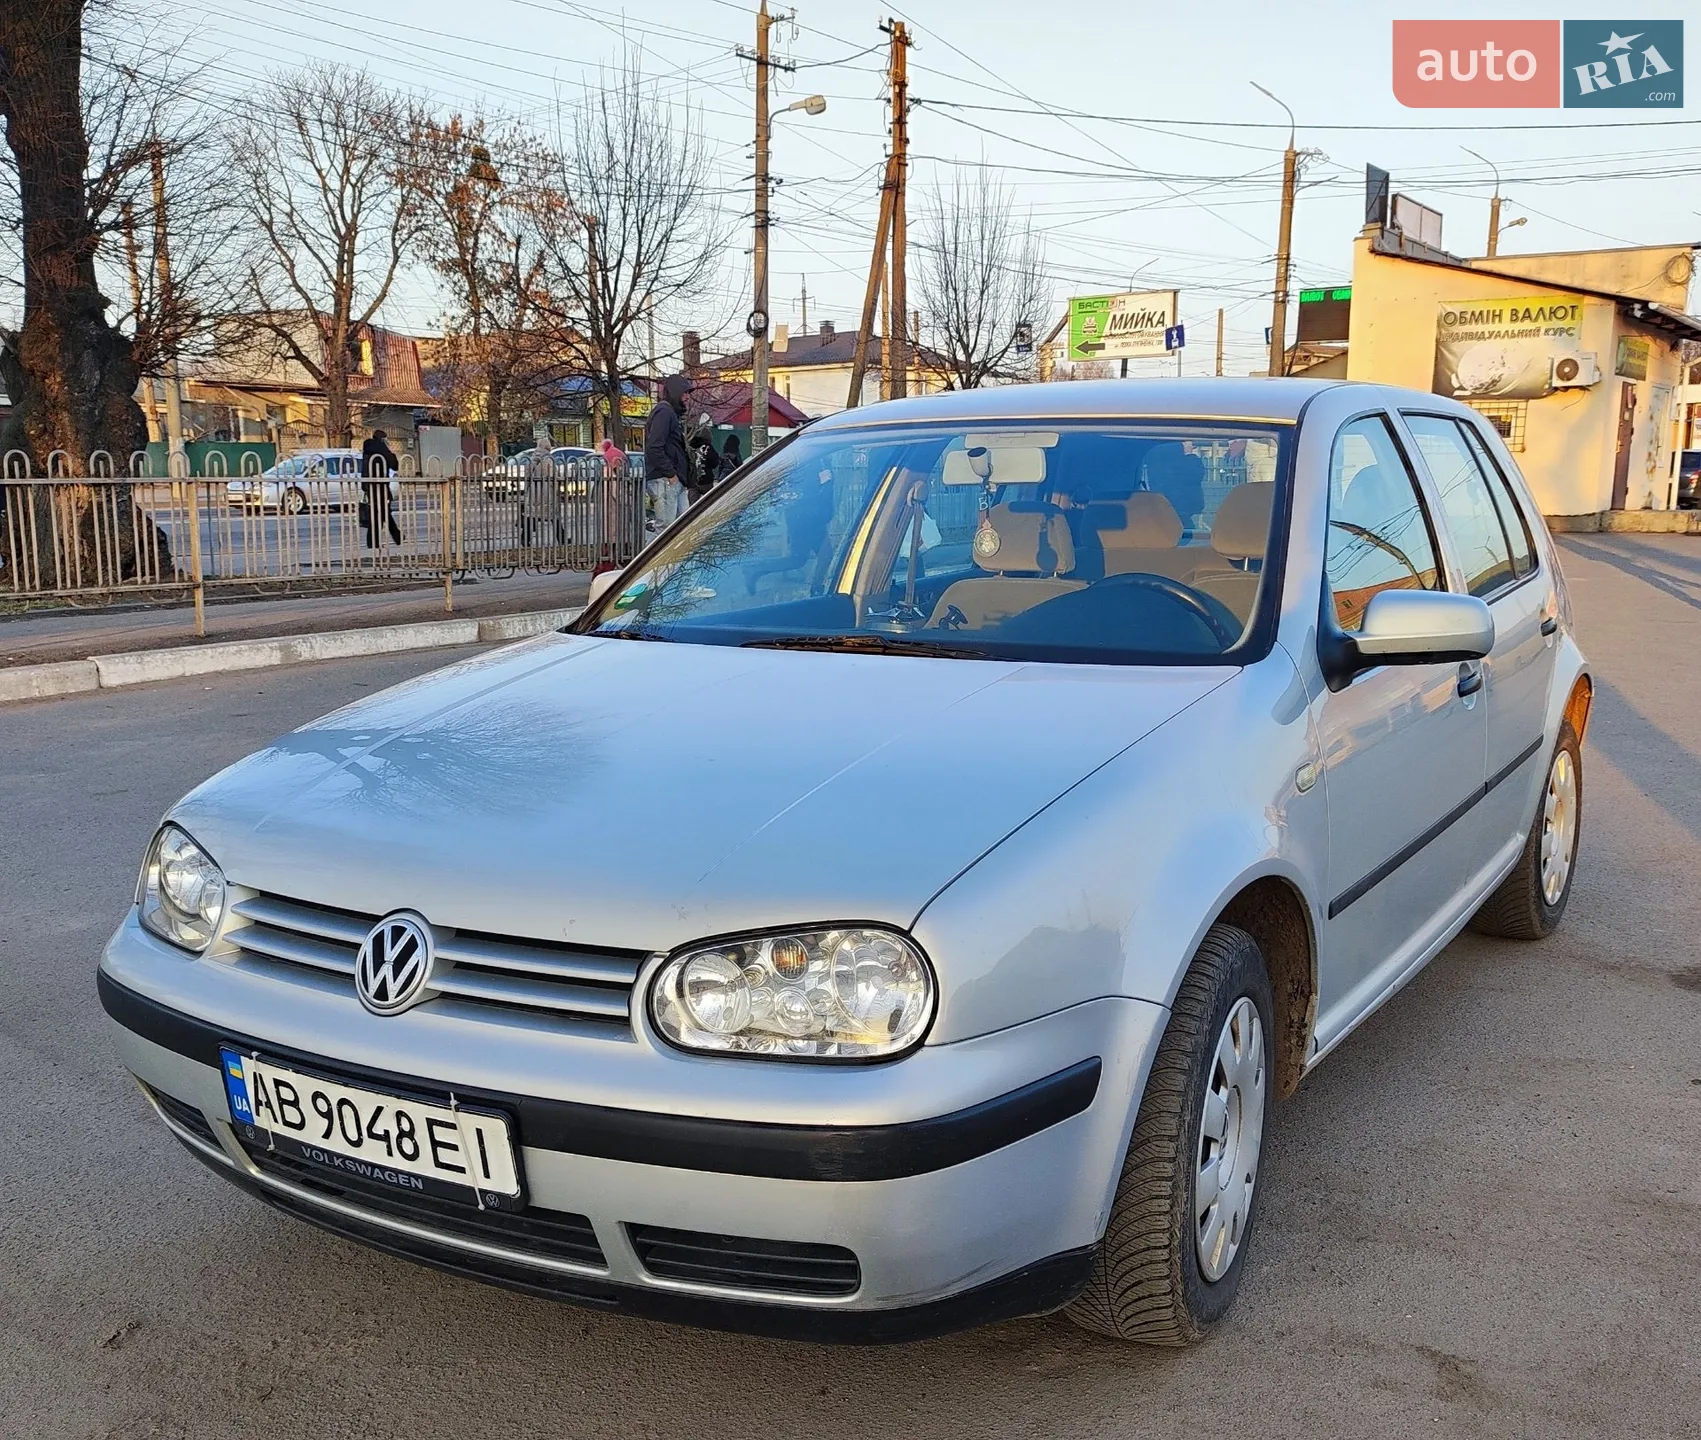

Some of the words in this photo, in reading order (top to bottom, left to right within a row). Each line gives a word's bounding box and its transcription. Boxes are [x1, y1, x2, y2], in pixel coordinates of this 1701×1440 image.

[1109, 308, 1166, 331] МИЙКА
[1443, 309, 1503, 327] ОБМІН
[1509, 305, 1579, 324] ВАЛЮТ
[1543, 326, 1576, 337] КУРС
[234, 1094, 251, 1114] UA
[301, 1145, 424, 1190] VOLKSWAGEN
